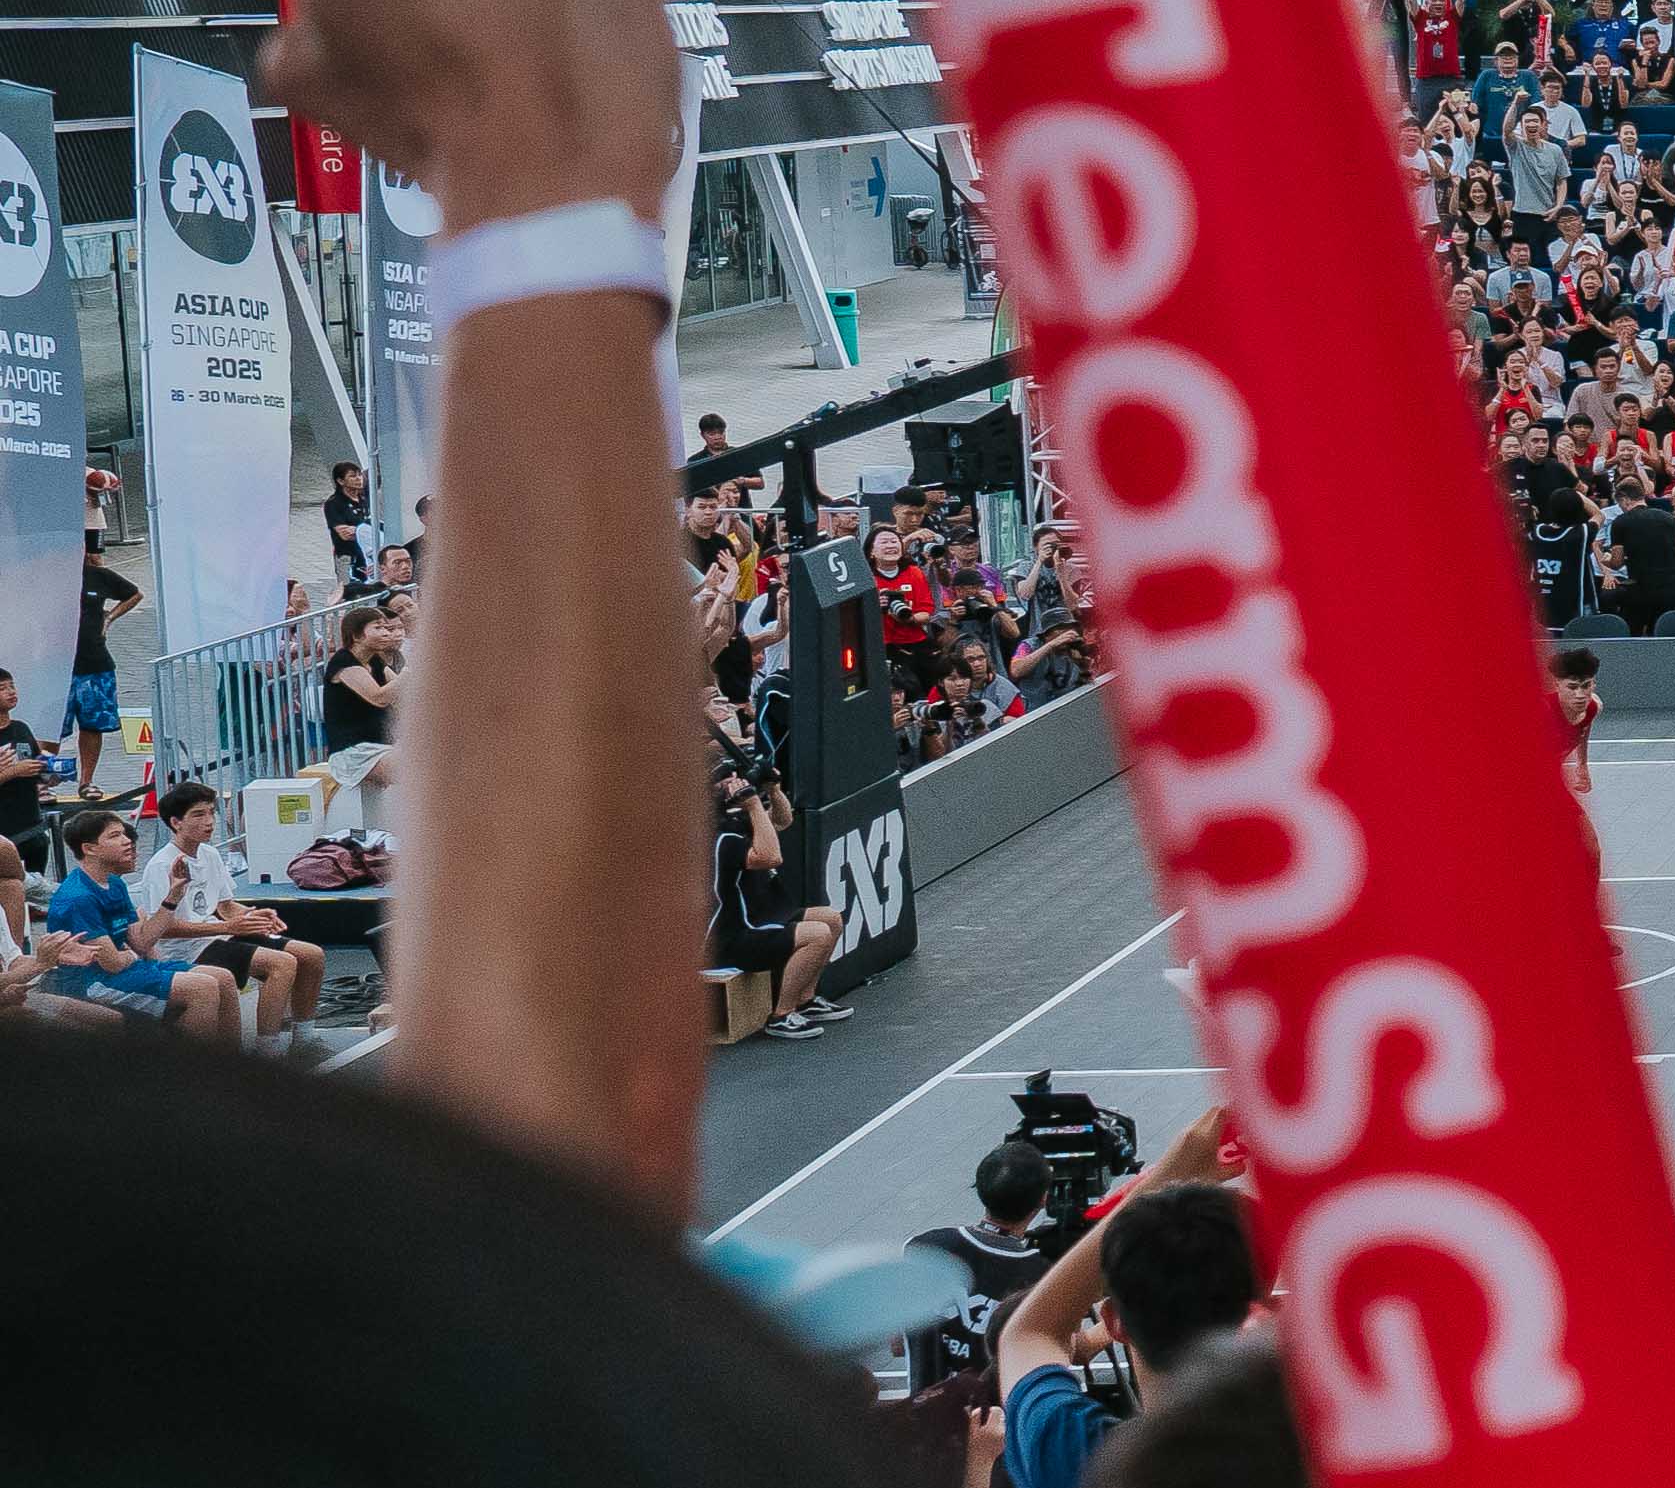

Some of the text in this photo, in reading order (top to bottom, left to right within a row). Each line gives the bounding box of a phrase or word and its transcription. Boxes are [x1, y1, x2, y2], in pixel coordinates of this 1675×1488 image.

[174, 292, 270, 321] ASIA CUP
[171, 324, 279, 353] SINGAPORE
[388, 318, 433, 343] 2025
[15, 332, 56, 360] CUP
[0, 366, 63, 396] APORE
[207, 357, 262, 381] 2025
[198, 390, 221, 403] 30
[224, 391, 262, 406] March
[0, 400, 41, 427] 025
[41, 438, 71, 459] 2025
